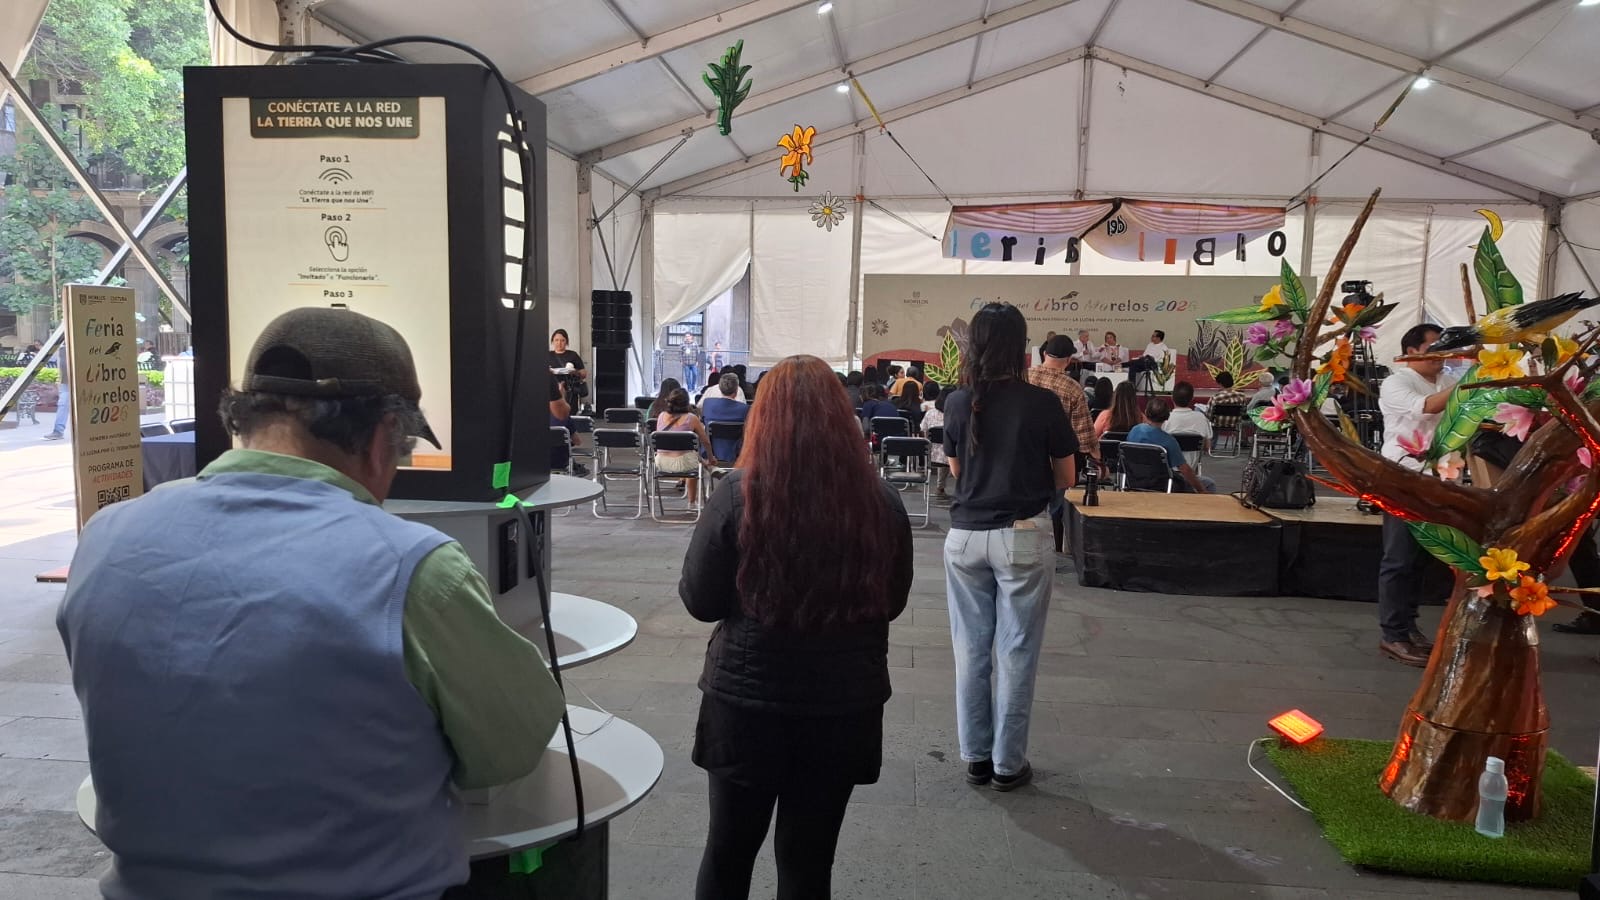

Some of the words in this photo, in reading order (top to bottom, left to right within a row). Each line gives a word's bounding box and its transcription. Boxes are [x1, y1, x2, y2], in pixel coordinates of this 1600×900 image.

[268, 99, 340, 113] CONÉCTATE
[344, 102, 353, 113] A
[357, 102, 372, 113] LA
[376, 102, 401, 113] RED
[257, 116, 274, 127] LA
[277, 116, 322, 127] TIERRA
[325, 116, 352, 129] QUE
[355, 116, 382, 127] NOS
[386, 116, 413, 127] UNE
[320, 154, 342, 163] Paso
[344, 155, 350, 163] 1
[321, 213, 343, 222] Paso
[345, 213, 351, 222] 2
[324, 289, 345, 298] Paso
[347, 290, 353, 298] 3
[1034, 298, 1079, 312] Libro
[86, 316, 124, 337] Feria
[86, 363, 126, 383] Libro
[88, 460, 124, 473] PROGRAMA
[125, 459, 135, 467] DE
